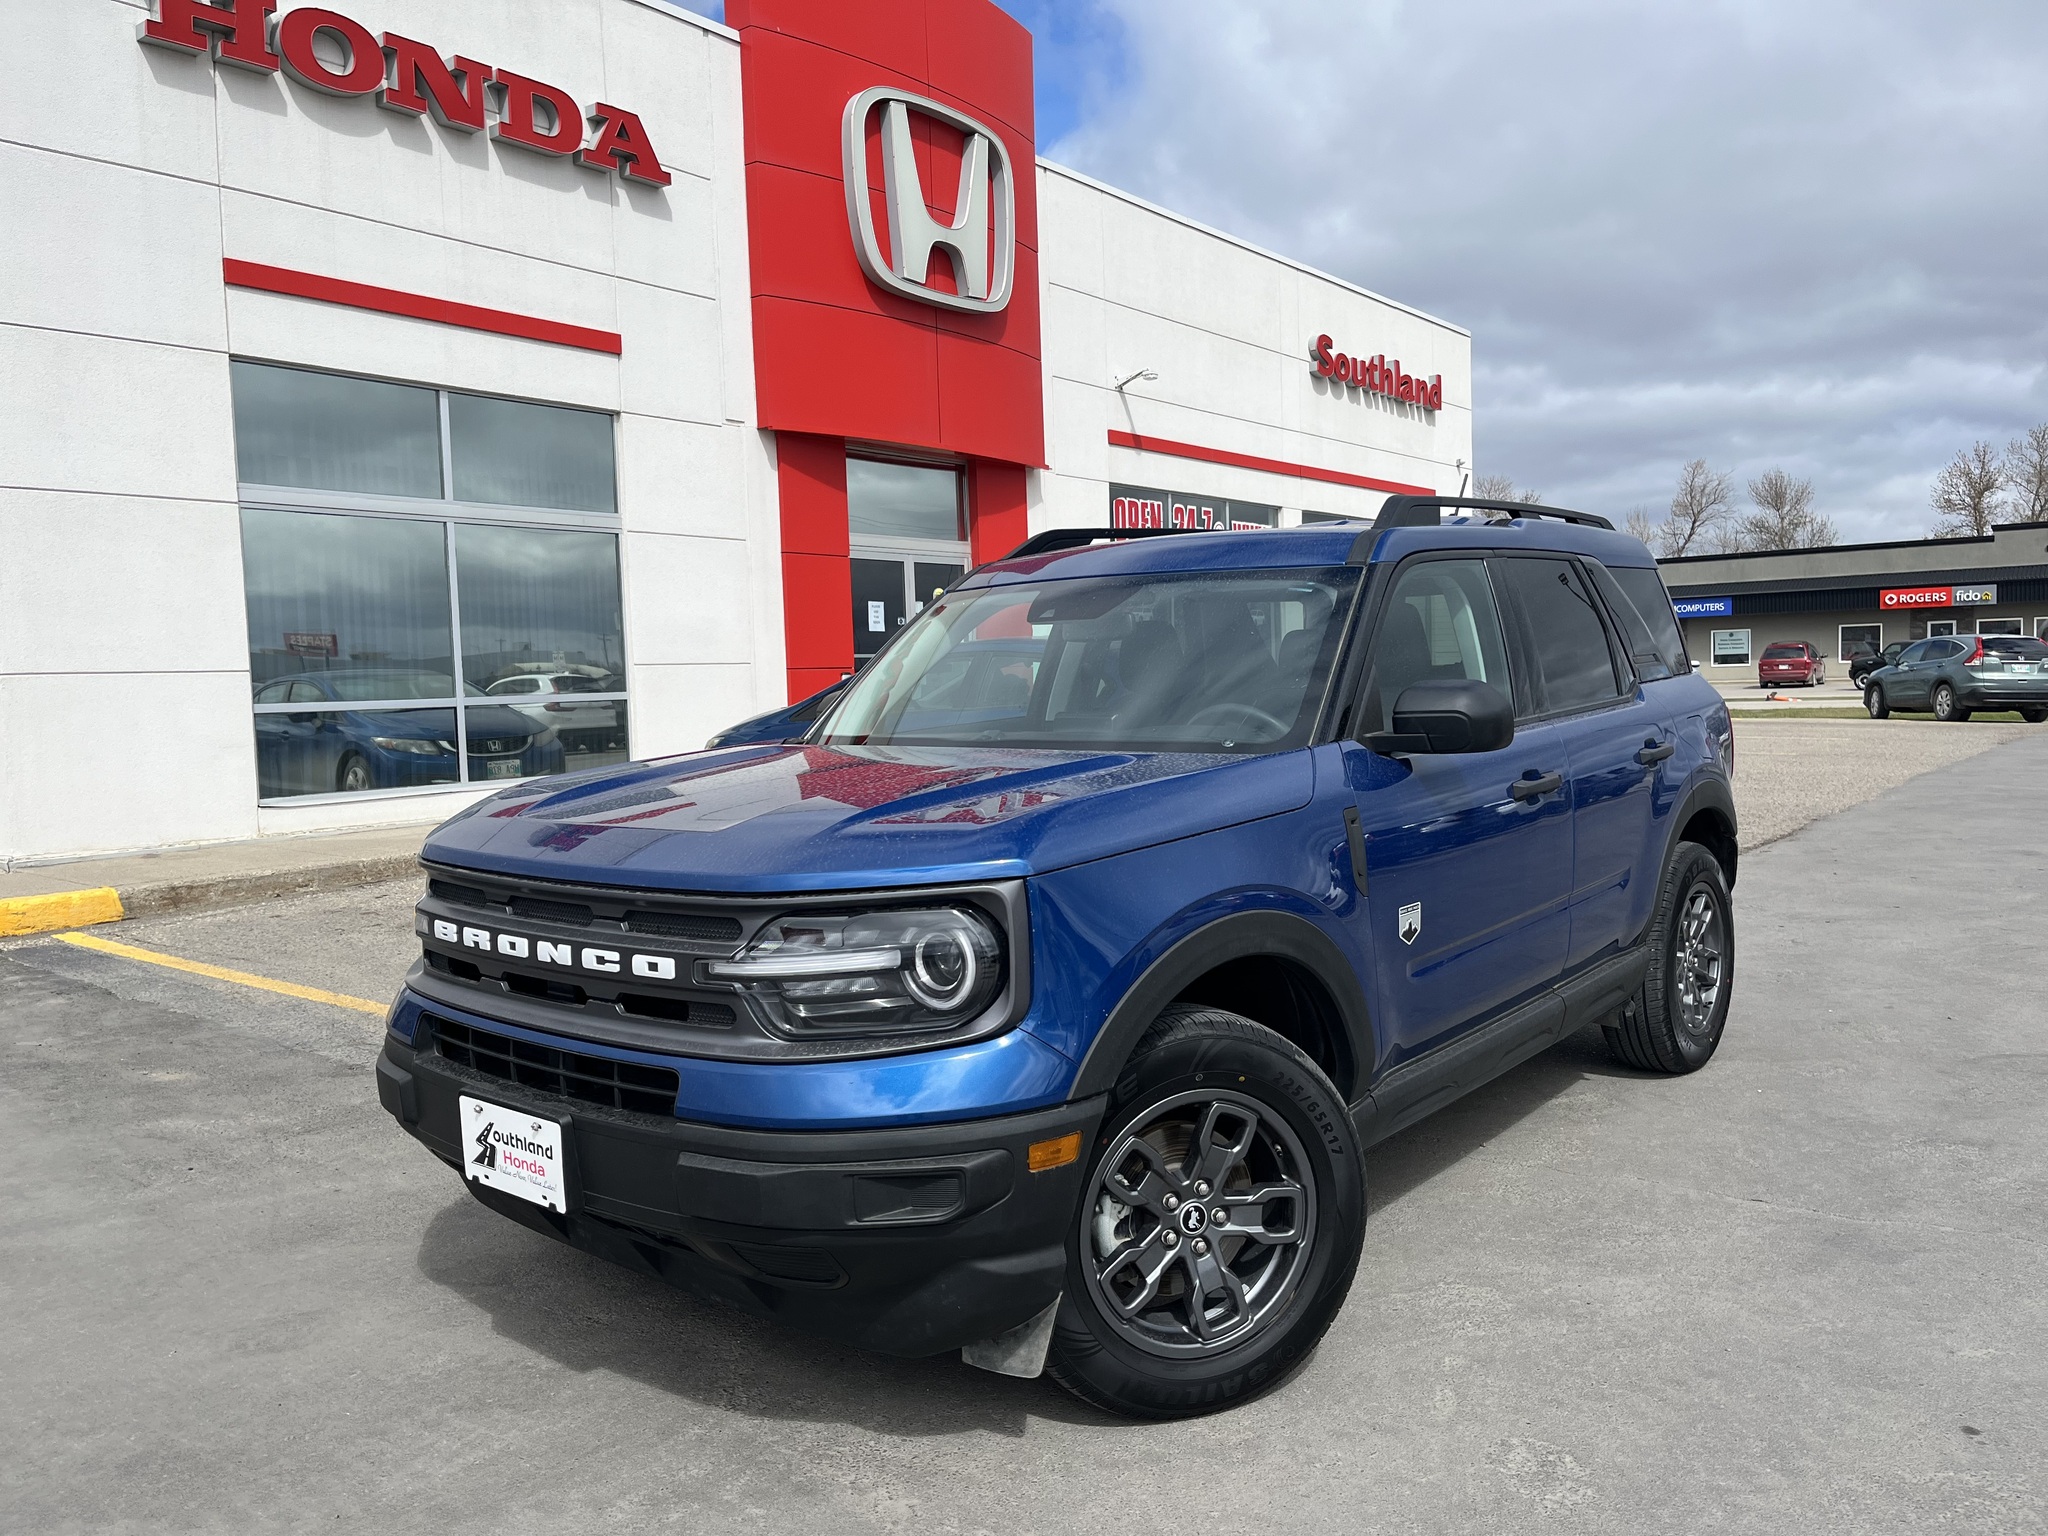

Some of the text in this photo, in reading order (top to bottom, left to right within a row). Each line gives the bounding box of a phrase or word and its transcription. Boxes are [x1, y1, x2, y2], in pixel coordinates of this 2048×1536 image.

[136, 0, 672, 189] HONDA
[1308, 333, 1442, 411] Southland
[1113, 497, 1164, 530] OPEN
[1900, 592, 1947, 603] ROGERS
[1956, 590, 1981, 602] fido
[434, 919, 676, 980] BRONCO
[1274, 1071, 1344, 1155] 225/65R17
[503, 1150, 546, 1177] Honda
